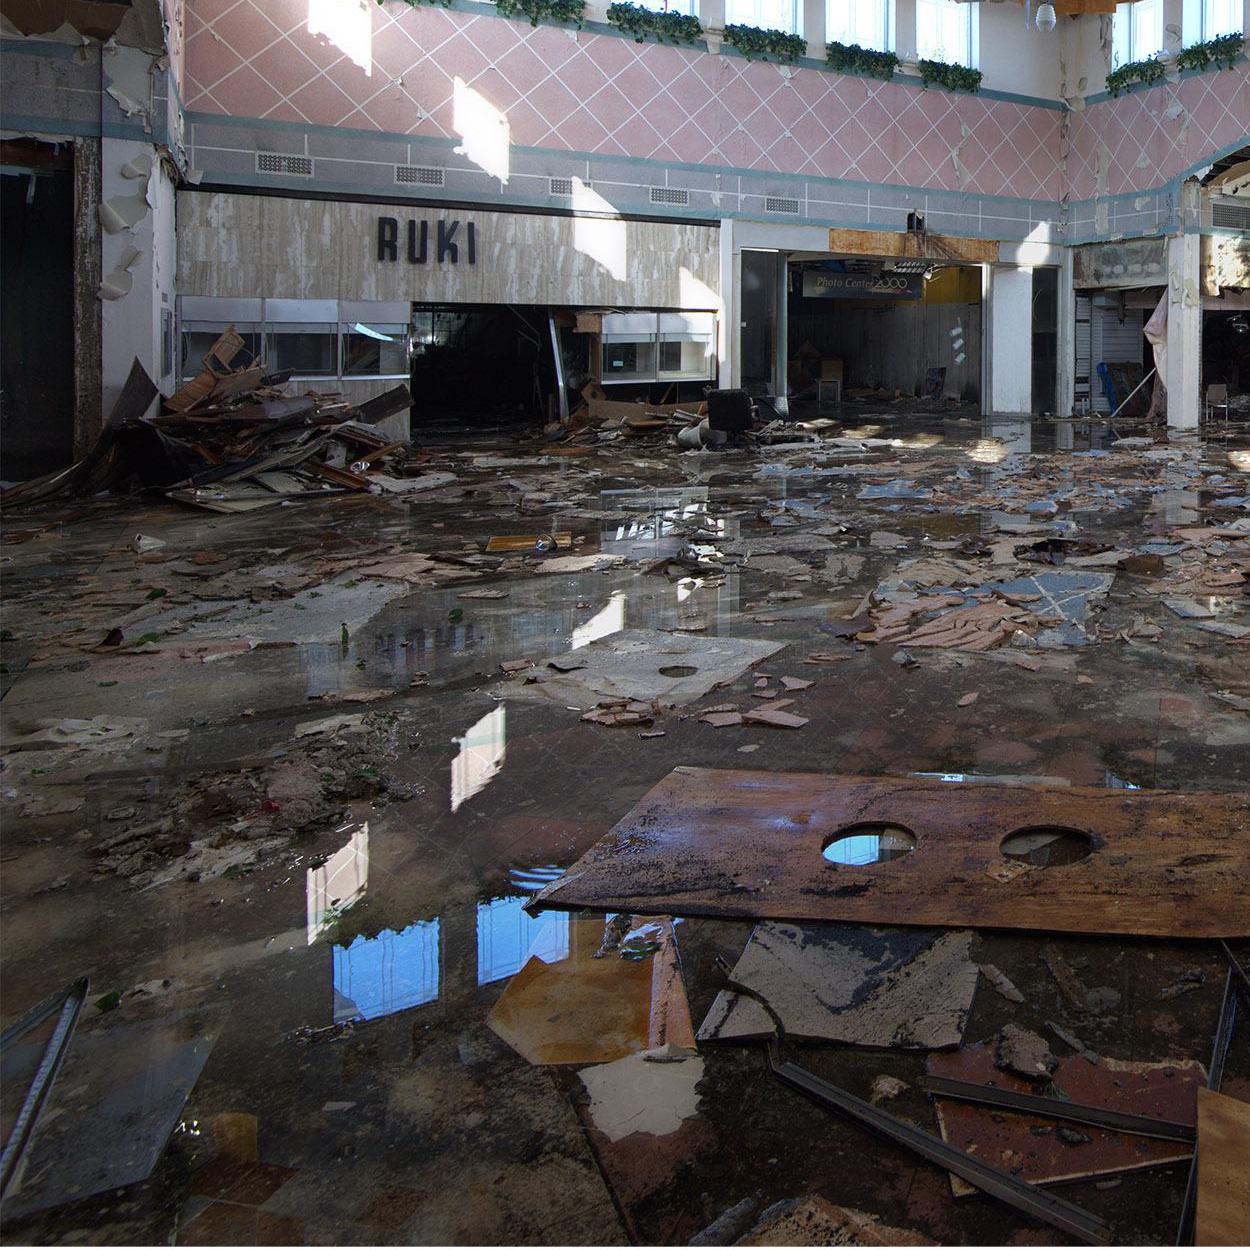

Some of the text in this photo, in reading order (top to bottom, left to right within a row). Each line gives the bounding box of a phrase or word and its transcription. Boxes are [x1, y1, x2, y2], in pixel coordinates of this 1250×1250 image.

[377, 216, 477, 264] RUKI
[816, 276, 908, 289] Photo Center 2000
